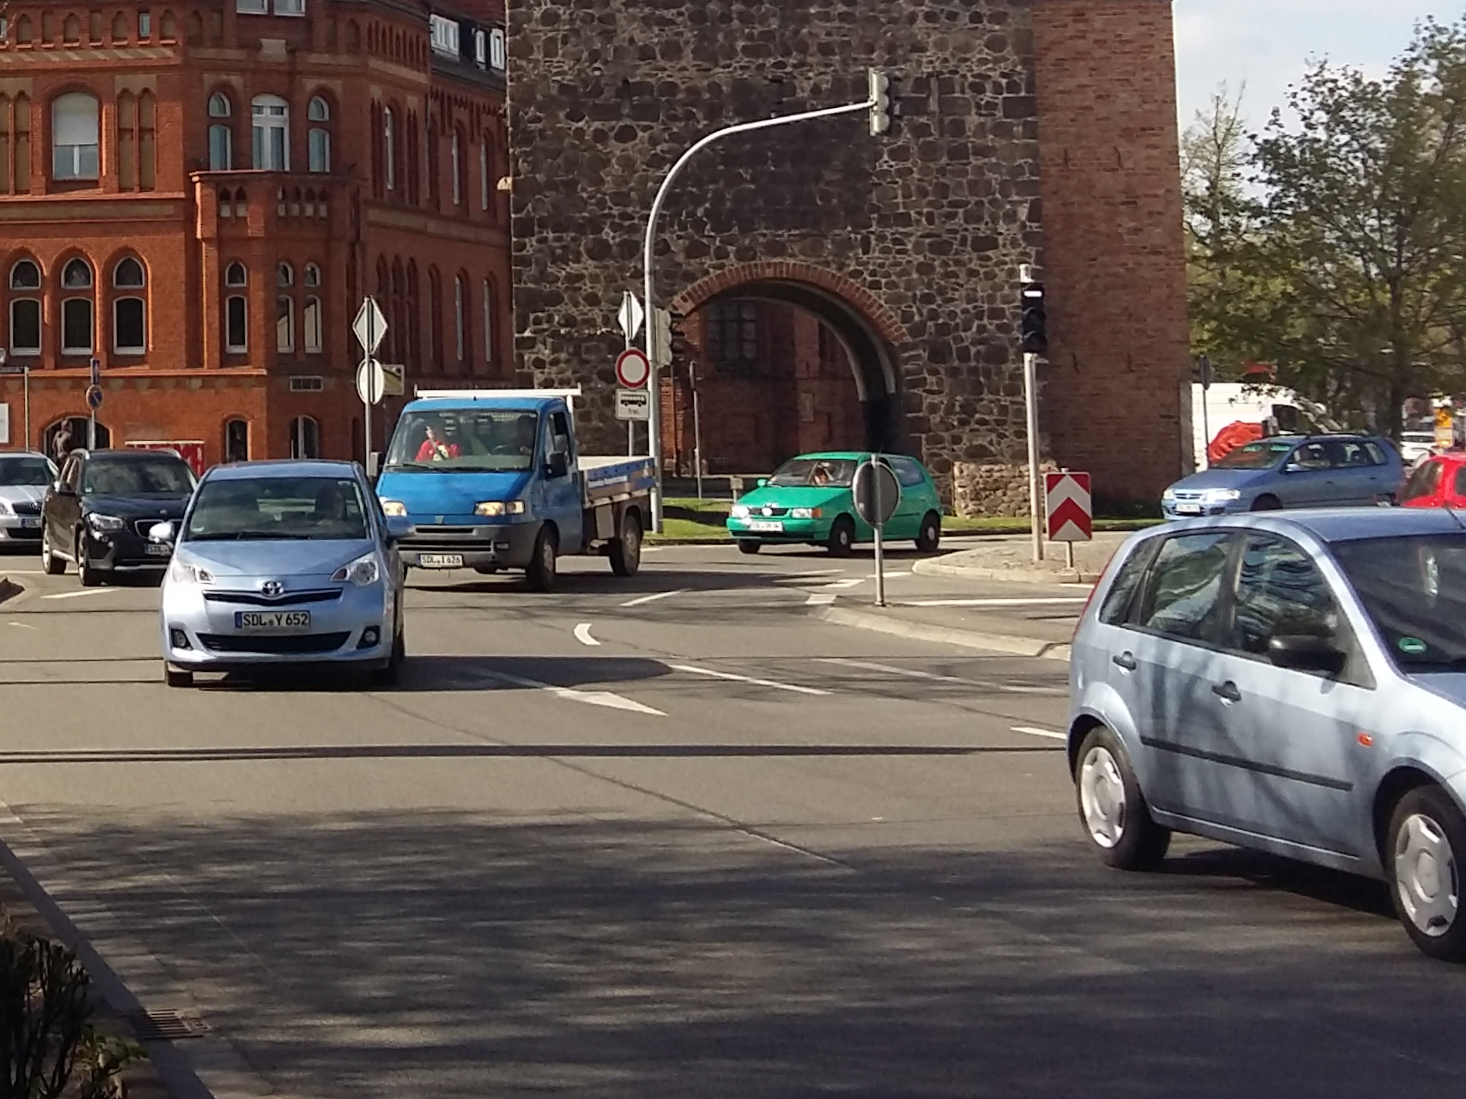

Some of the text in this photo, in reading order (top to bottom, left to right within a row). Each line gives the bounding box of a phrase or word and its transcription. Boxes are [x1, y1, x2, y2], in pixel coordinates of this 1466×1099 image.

[243, 613, 308, 626] SDL Y 652
